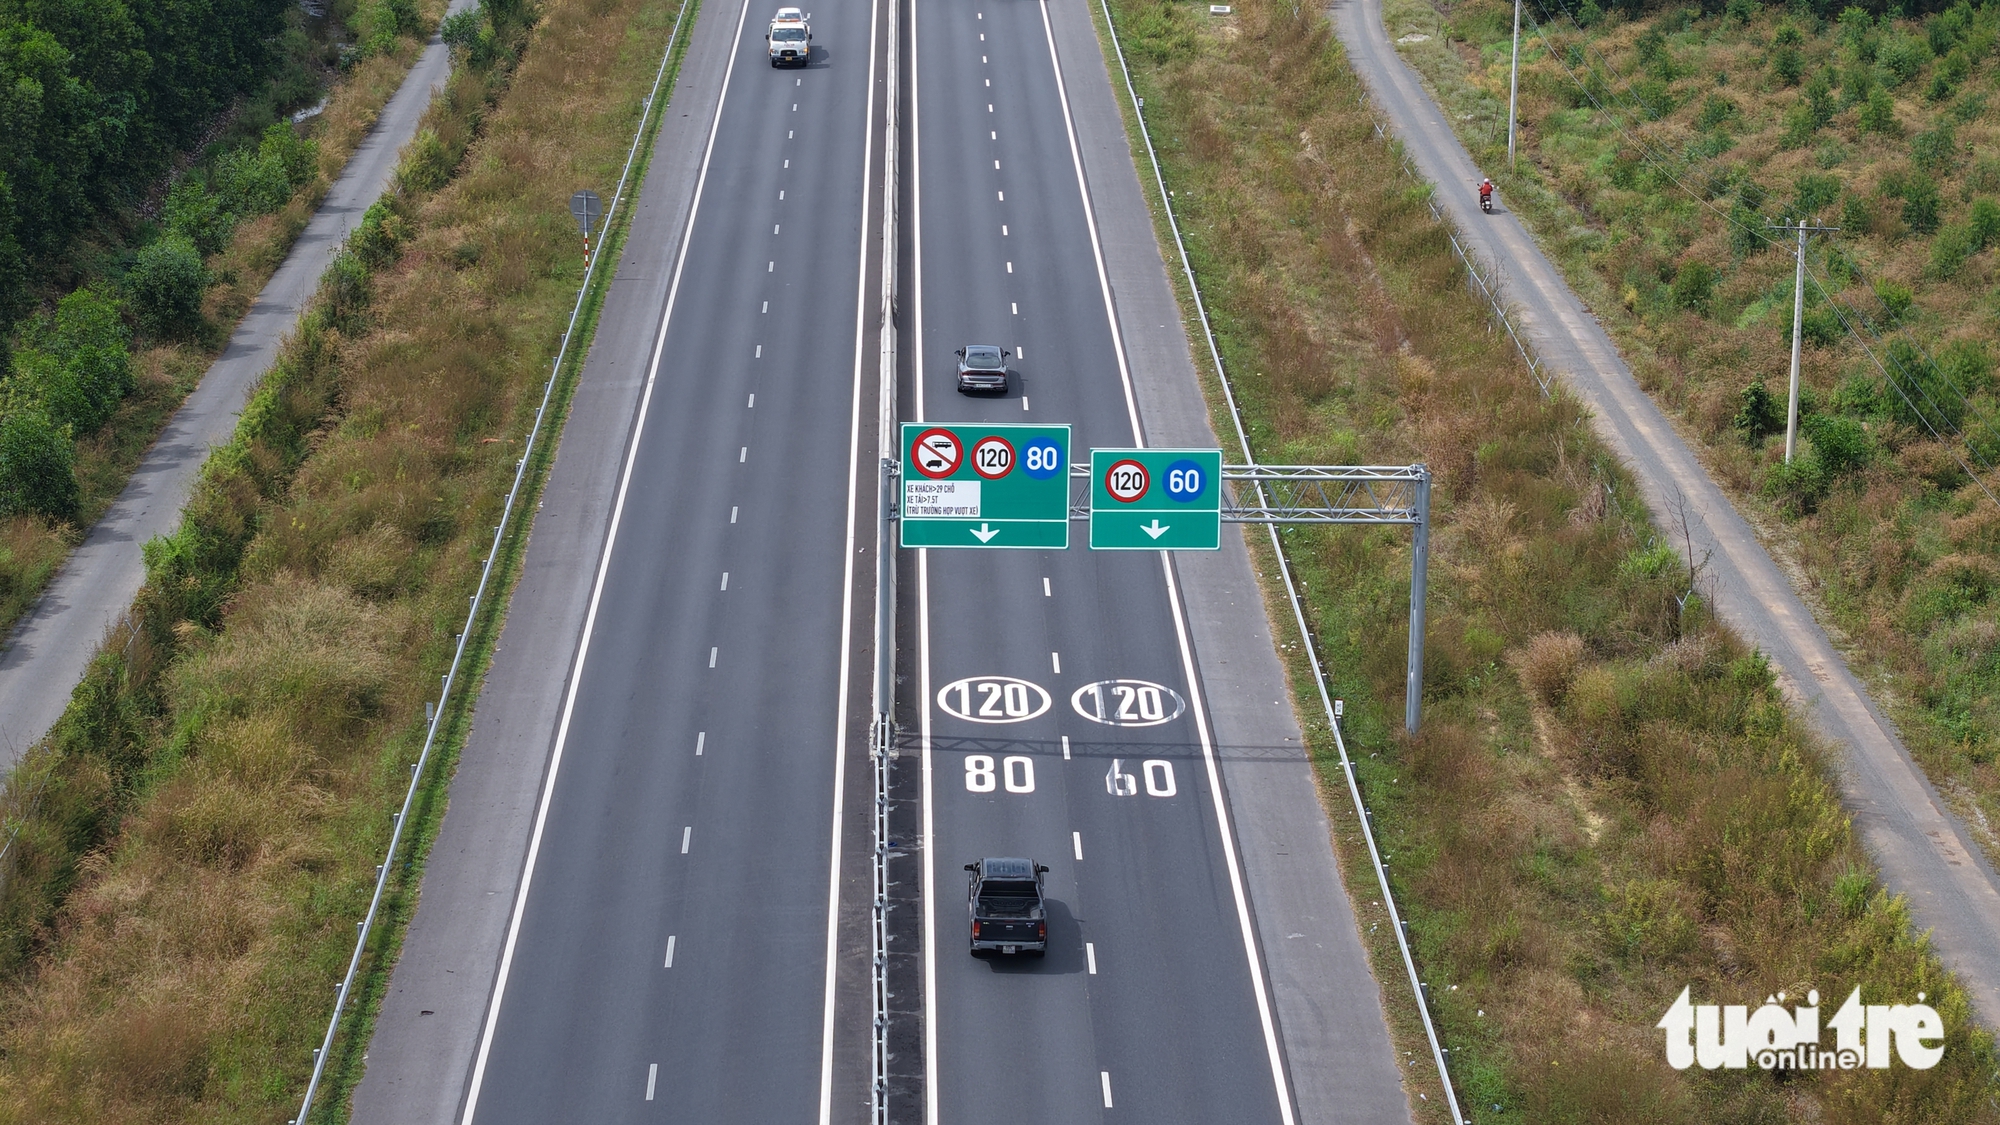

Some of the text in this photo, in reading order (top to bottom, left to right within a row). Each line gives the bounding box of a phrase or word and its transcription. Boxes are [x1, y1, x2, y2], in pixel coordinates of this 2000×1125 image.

[979, 448, 1009, 468] 120
[1026, 446, 1058, 471] 80
[907, 485, 914, 493] XE
[1113, 471, 1143, 491] 120
[1169, 469, 1200, 493] 60
[907, 495, 914, 503] XE
[921, 504, 942, 515] TRƯỜNG
[943, 506, 954, 516] HỢP
[954, 506, 969, 516] VƯỢT
[969, 506, 978, 515] XE)
[955, 682, 1030, 717] 120
[1087, 684, 1164, 720] 120
[964, 755, 1035, 794] 80
[1105, 758, 1177, 797] 60
